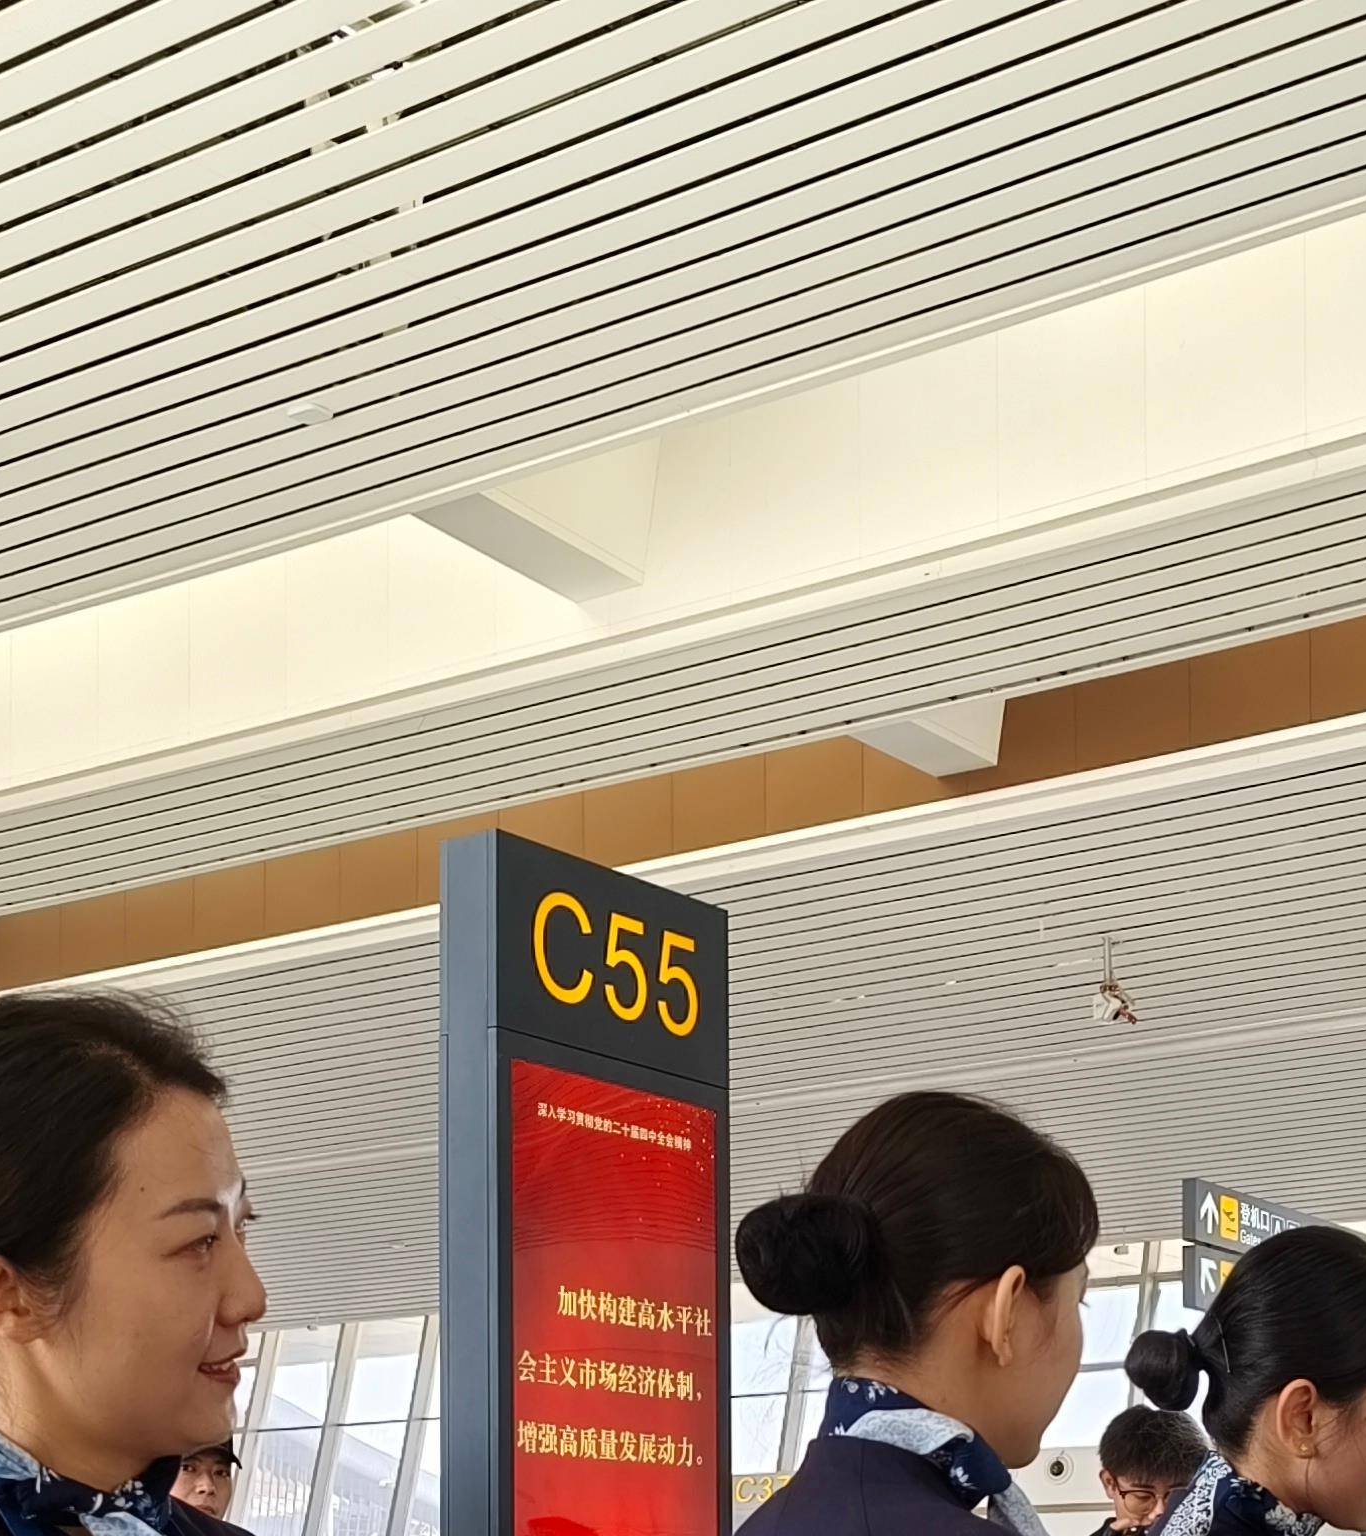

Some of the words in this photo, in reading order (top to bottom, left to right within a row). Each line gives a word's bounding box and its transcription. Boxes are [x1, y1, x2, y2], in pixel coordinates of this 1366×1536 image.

[534, 891, 698, 1037] C55
[1240, 1202, 1270, 1232] 登机口
[557, 1285, 713, 1337] 加快构建高水平社
[517, 1420, 703, 1467] 增强高质量发展动力。
